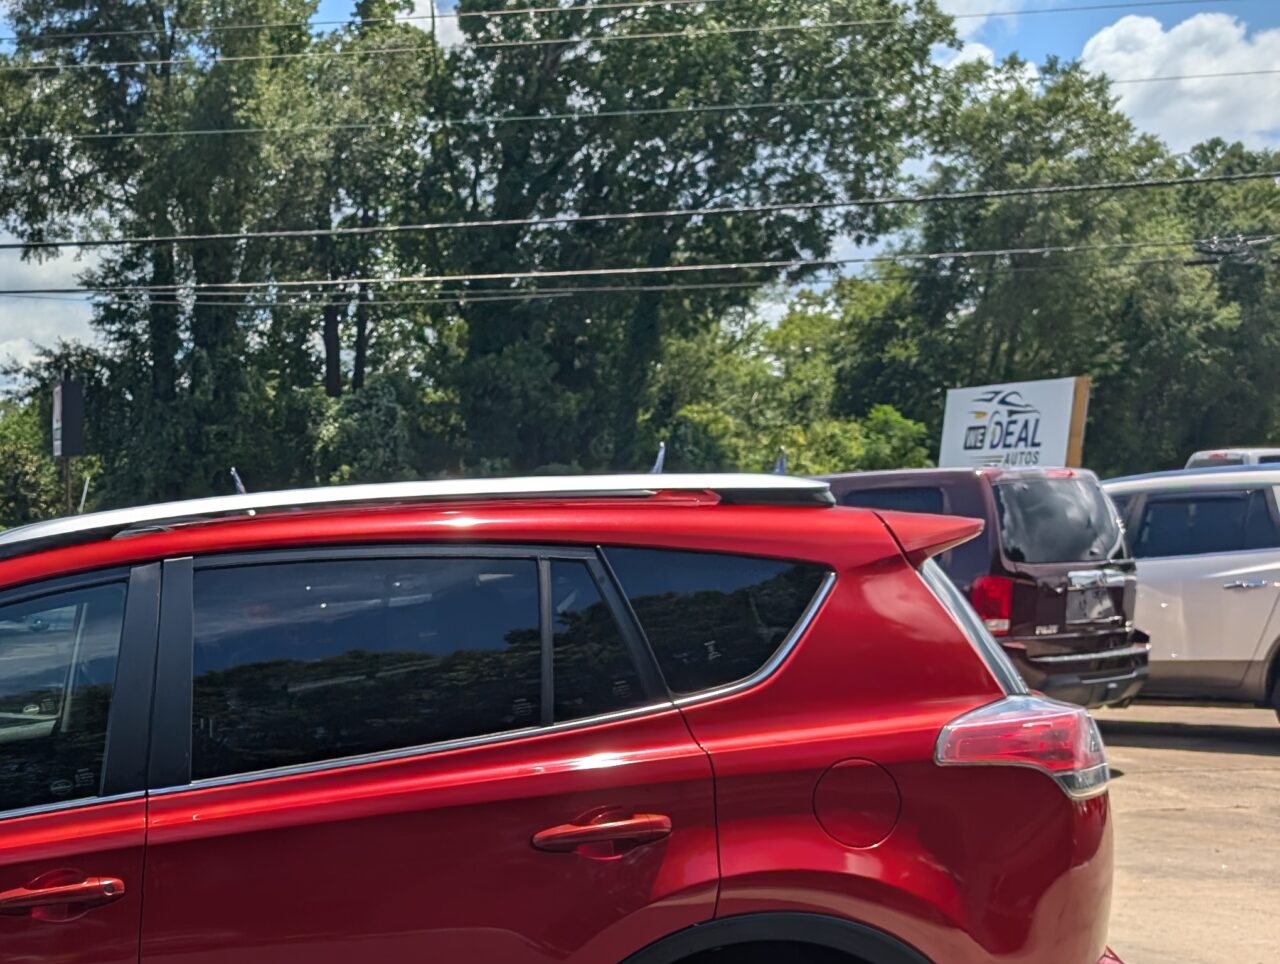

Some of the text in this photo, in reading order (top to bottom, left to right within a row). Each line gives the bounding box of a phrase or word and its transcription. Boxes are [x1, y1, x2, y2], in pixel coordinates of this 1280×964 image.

[964, 418, 1042, 450] WE DEAL
[1003, 451, 1040, 466] AUTOS
